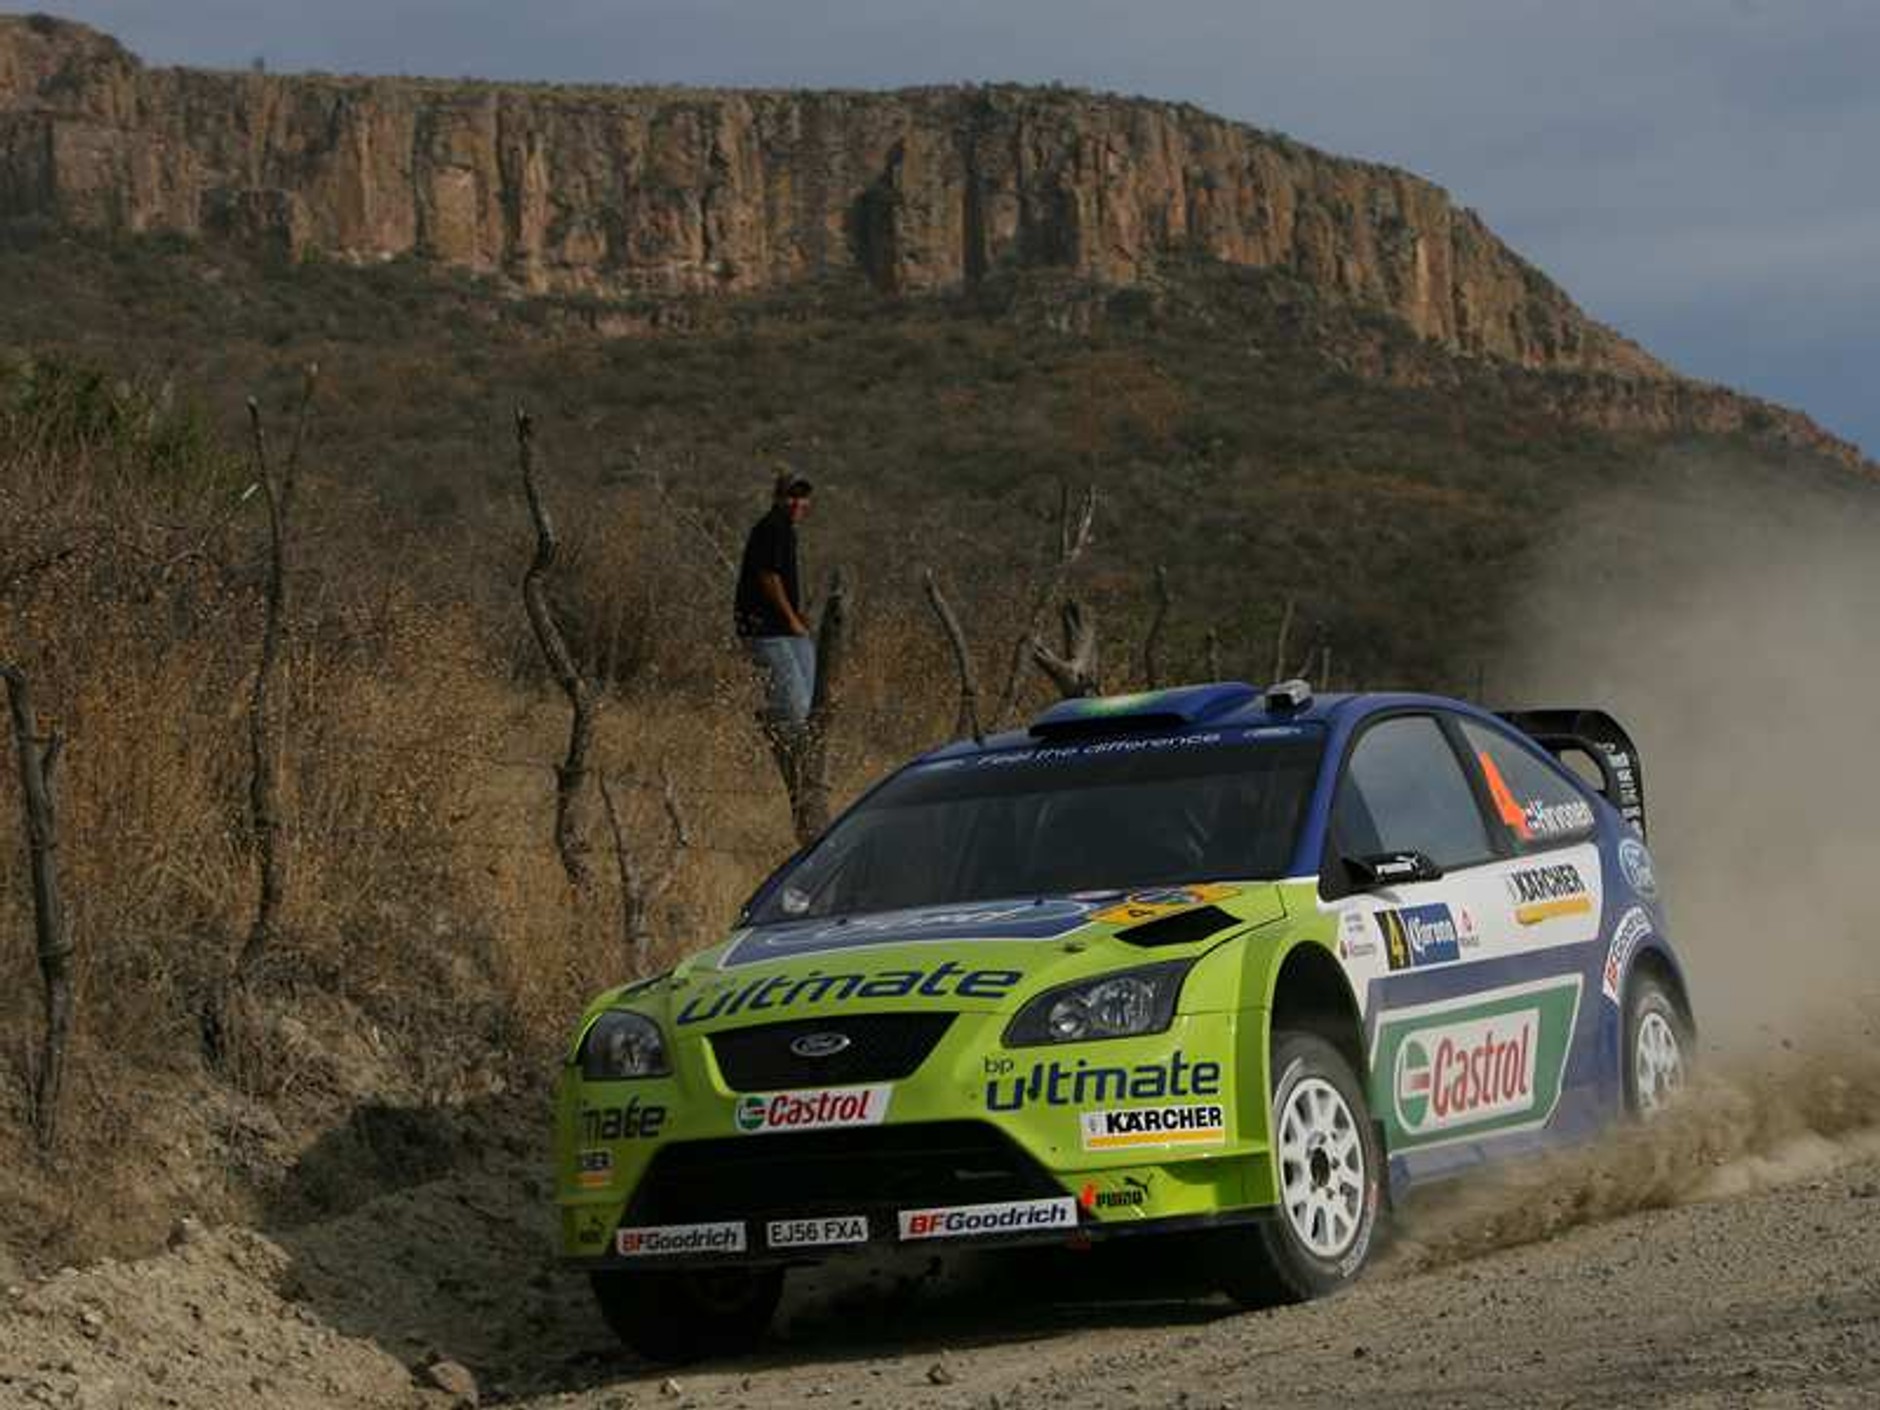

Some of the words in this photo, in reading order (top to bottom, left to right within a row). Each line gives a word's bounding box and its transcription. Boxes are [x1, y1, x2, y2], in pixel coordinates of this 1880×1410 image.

[1385, 911, 1405, 966] 4
[676, 961, 1024, 1027] ultimate
[984, 1056, 1014, 1074] bp
[986, 1050, 1221, 1112] ultimate
[1432, 1023, 1529, 1118] Castrol
[767, 1090, 871, 1127] Castrol
[1105, 1106, 1222, 1134] KÄRCHER
[770, 1224, 817, 1243] EJ56
[824, 1220, 864, 1240] FXA
[908, 1204, 1067, 1235] BFGoodrich
[621, 1228, 738, 1252] BFGoodrich
